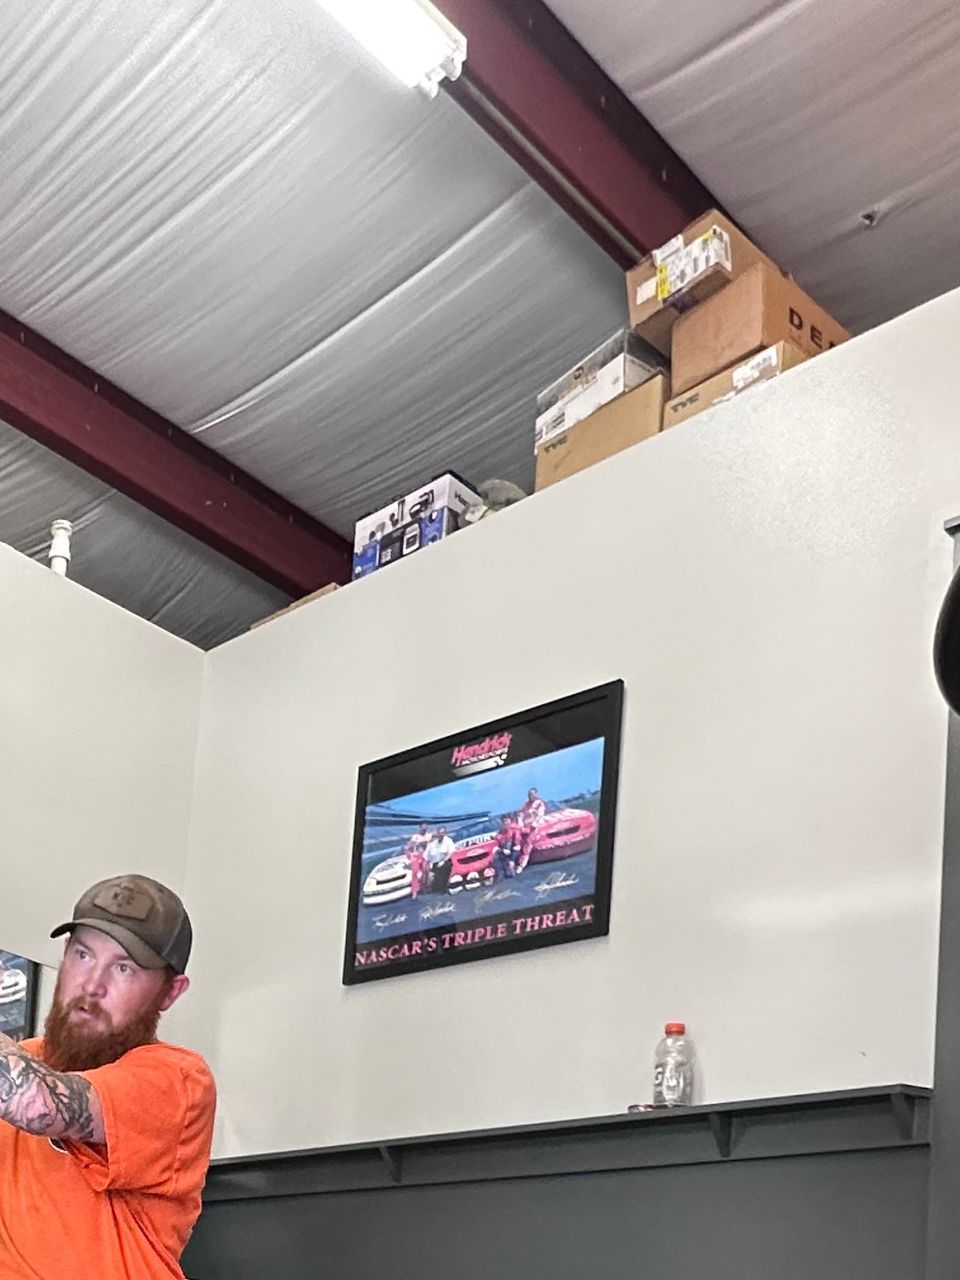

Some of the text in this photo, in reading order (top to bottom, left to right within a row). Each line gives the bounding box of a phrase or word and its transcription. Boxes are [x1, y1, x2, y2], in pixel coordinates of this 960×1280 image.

[789, 306, 840, 350] DE
[451, 731, 512, 768] Hendrick
[354, 936, 437, 966] NASCAR'S
[442, 920, 506, 949] TRIPLE
[512, 904, 595, 935] THREAT
